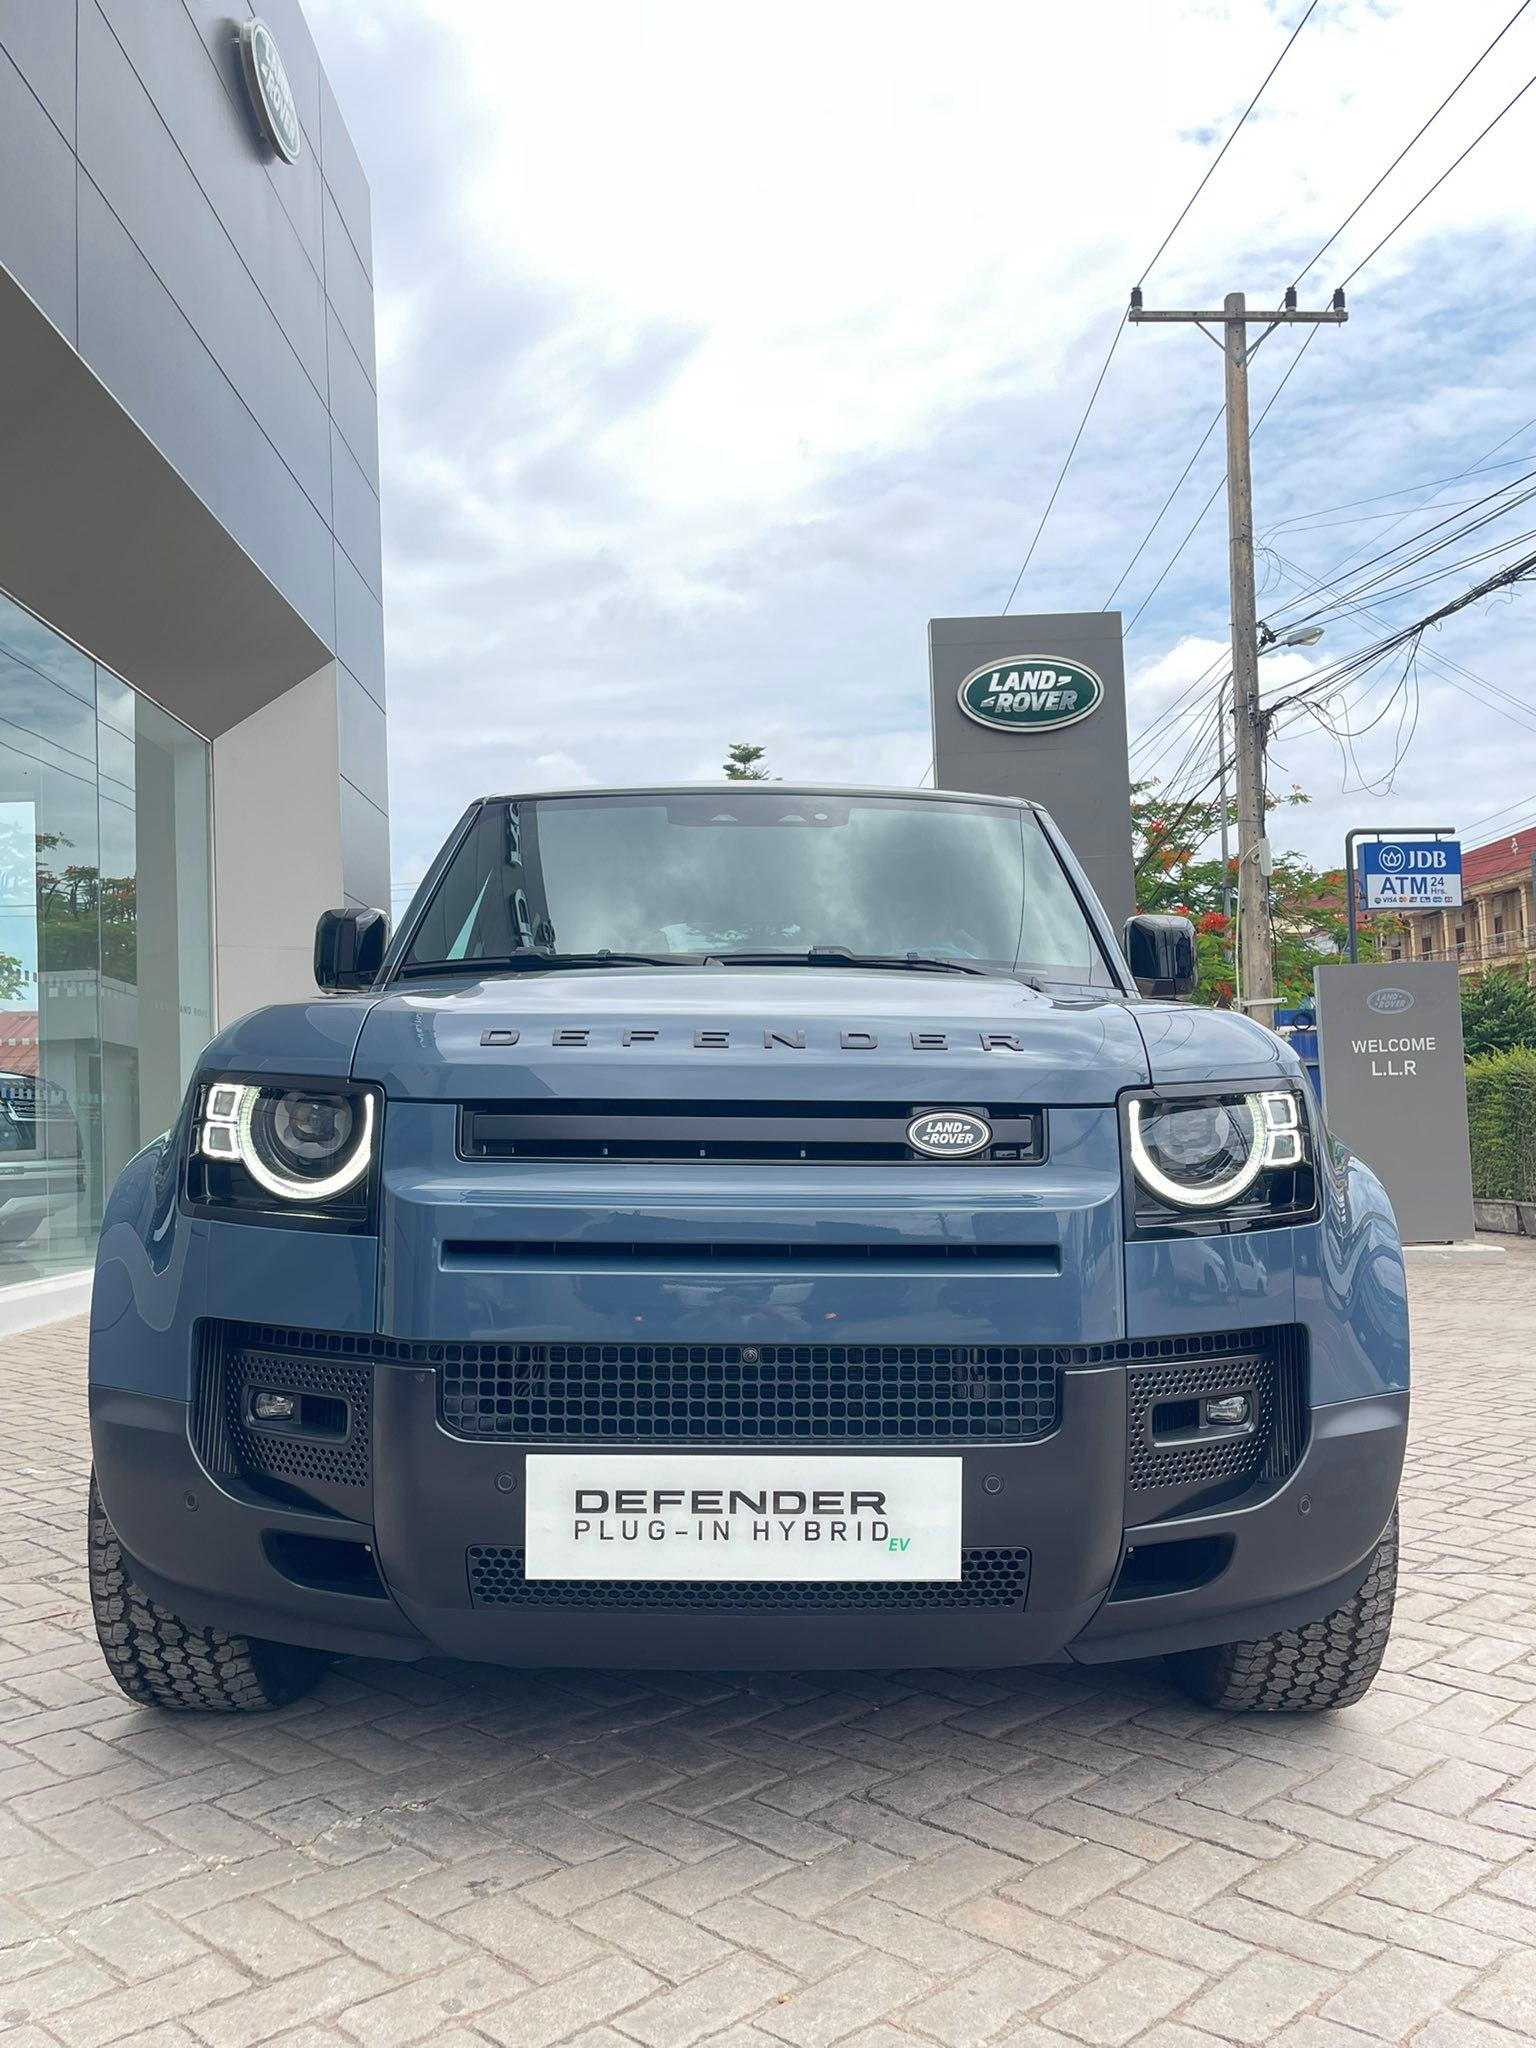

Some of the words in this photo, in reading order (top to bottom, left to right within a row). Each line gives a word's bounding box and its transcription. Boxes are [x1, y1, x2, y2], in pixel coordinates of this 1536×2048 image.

[988, 670, 1057, 692] LAND
[994, 690, 1078, 713] ROVER
[1408, 851, 1447, 869] JDB
[1380, 877, 1428, 895] ATM
[1430, 876, 1445, 887] 24
[1377, 993, 1398, 1002] LAND
[1378, 1000, 1406, 1009] ROVER
[479, 1028, 1025, 1052] DEFENDER
[1351, 1036, 1436, 1054] WELCOME
[1371, 1060, 1417, 1076] L.L.R
[926, 1122, 963, 1133] LAND
[929, 1133, 974, 1144] ROVER
[574, 1489, 888, 1516] DEFENDER
[574, 1519, 731, 1542] PLUG-IN
[753, 1520, 890, 1543] HYBRID
[888, 1537, 911, 1552] EV
